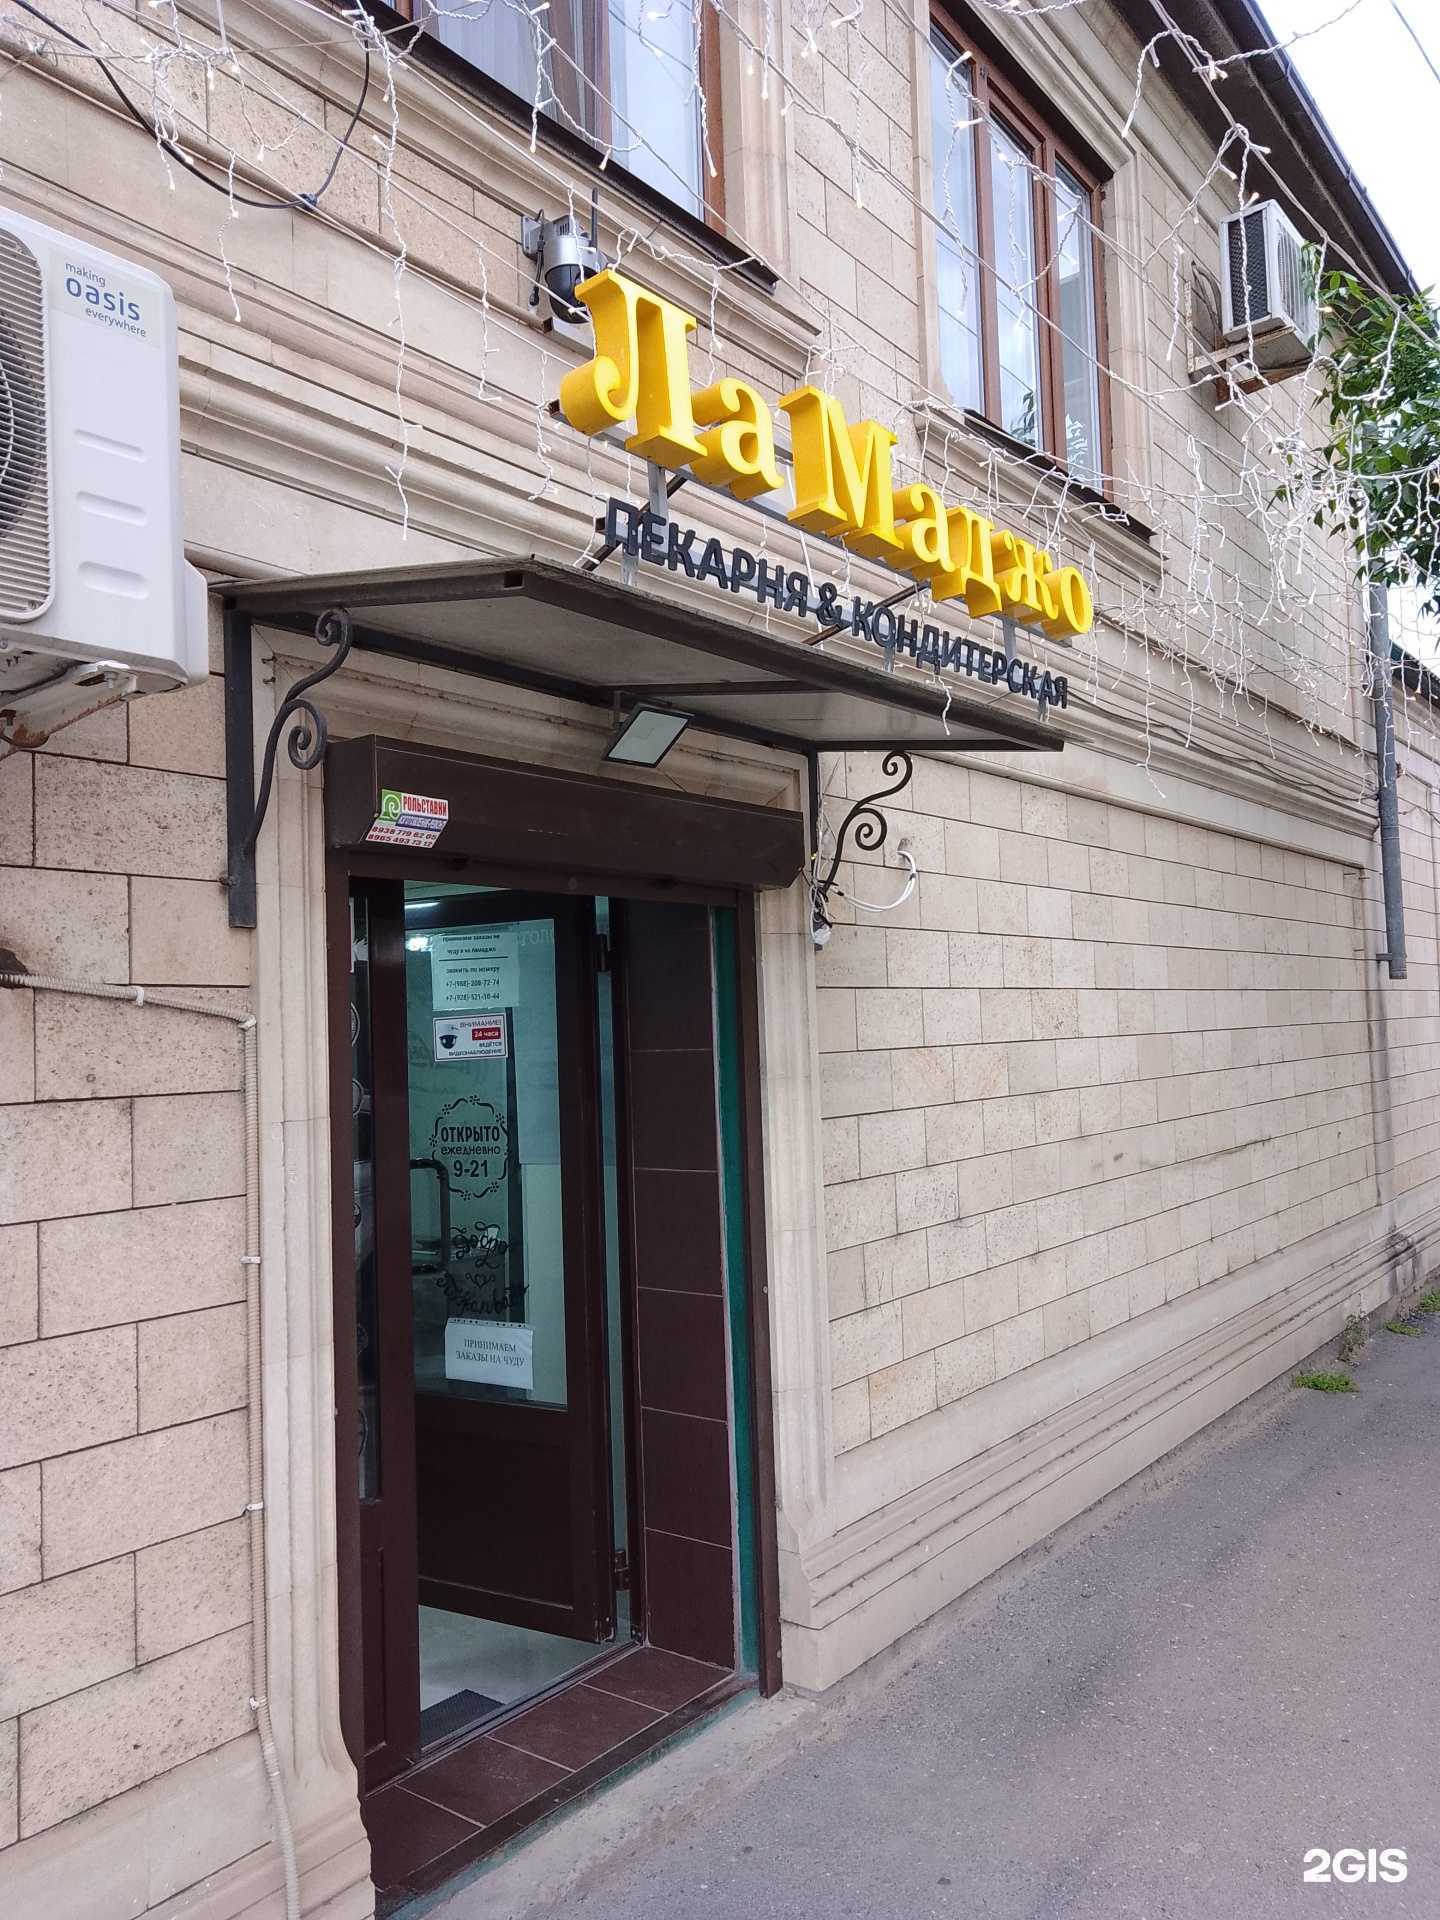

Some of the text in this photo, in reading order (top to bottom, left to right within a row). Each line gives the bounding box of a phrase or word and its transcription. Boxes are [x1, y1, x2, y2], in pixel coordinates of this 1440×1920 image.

[65, 262, 106, 287] making
[66, 277, 140, 321] oasis
[86, 308, 146, 337] everywhere
[605, 497, 1069, 709] ПЕКАРНЯ & КОНДИТЕРСКАЯ
[441, 1126, 500, 1142] ОТКРЫТО
[441, 1146, 500, 1155] ежедневно
[454, 1160, 488, 1177] 9-21
[464, 1339, 516, 1353] ПРИНИМАЕМ
[456, 1350, 525, 1367] ЗАКАЗЫ НА ЧУДУ
